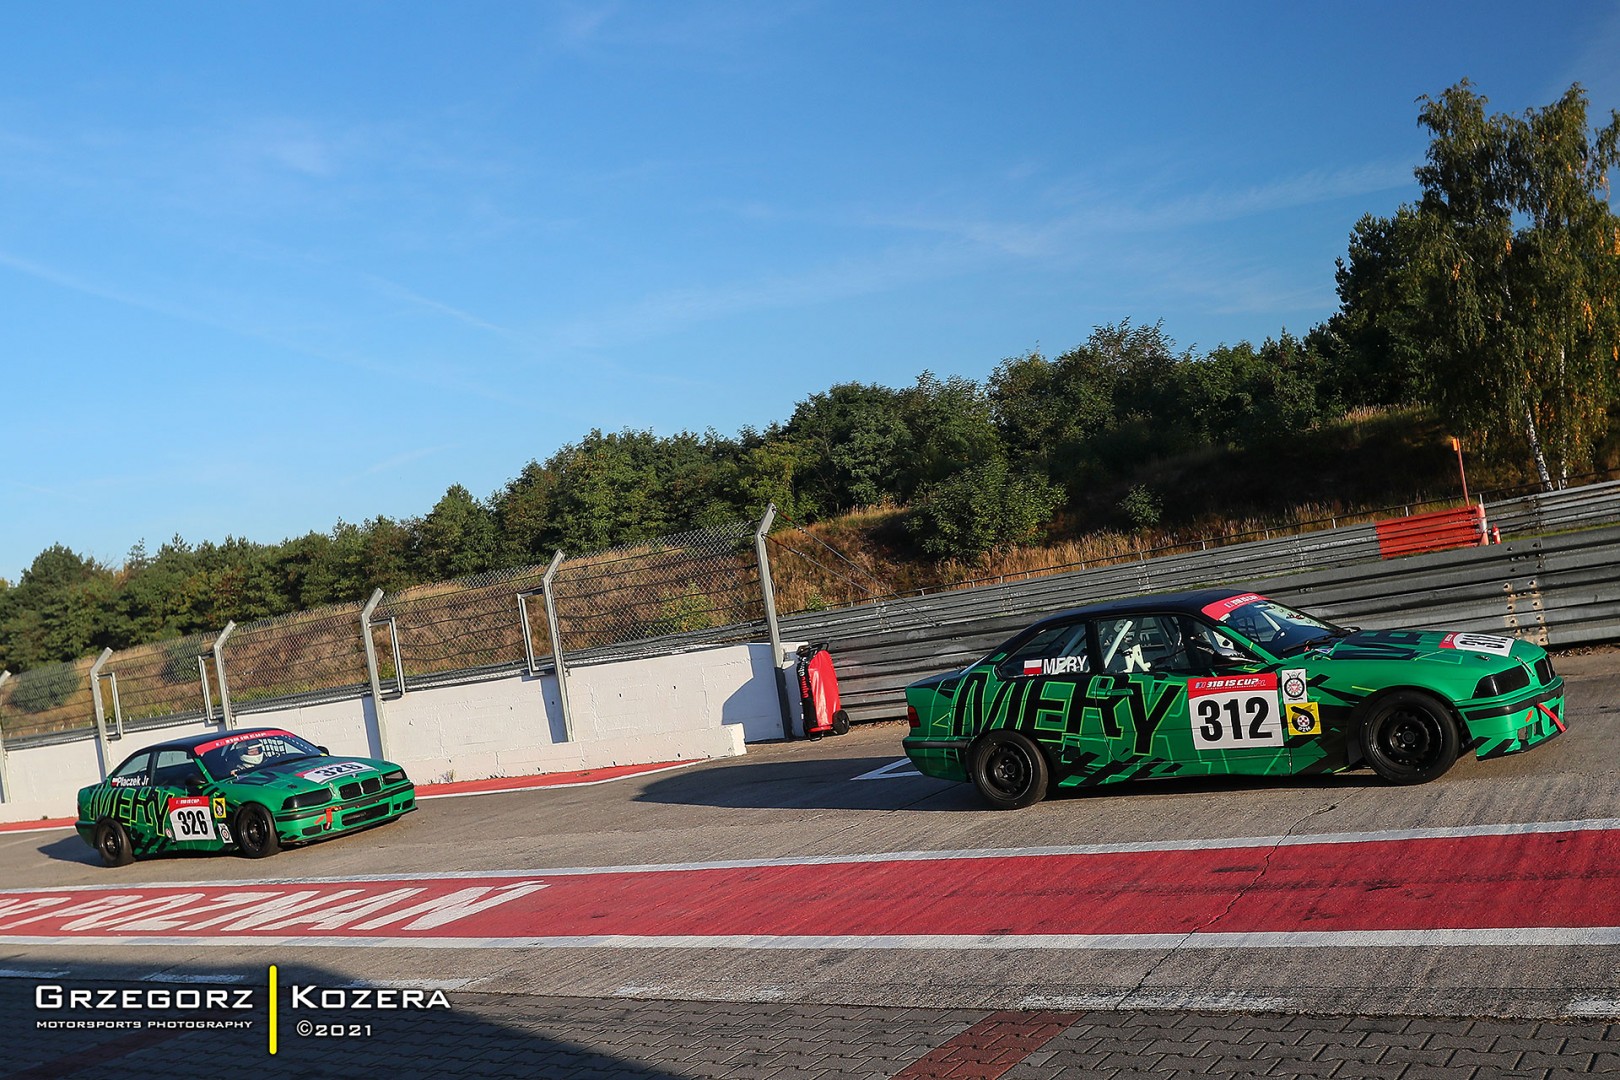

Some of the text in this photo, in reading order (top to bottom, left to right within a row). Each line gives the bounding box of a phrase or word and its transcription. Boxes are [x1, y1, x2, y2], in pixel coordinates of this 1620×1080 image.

[1043, 655, 1088, 675] MERY
[1207, 678, 1259, 688] 318 IS CUP
[951, 671, 1187, 756] MERY
[1197, 696, 1273, 742] 312
[141, 775, 150, 786] Jr
[89, 785, 175, 837] MERY
[177, 810, 208, 836] 326
